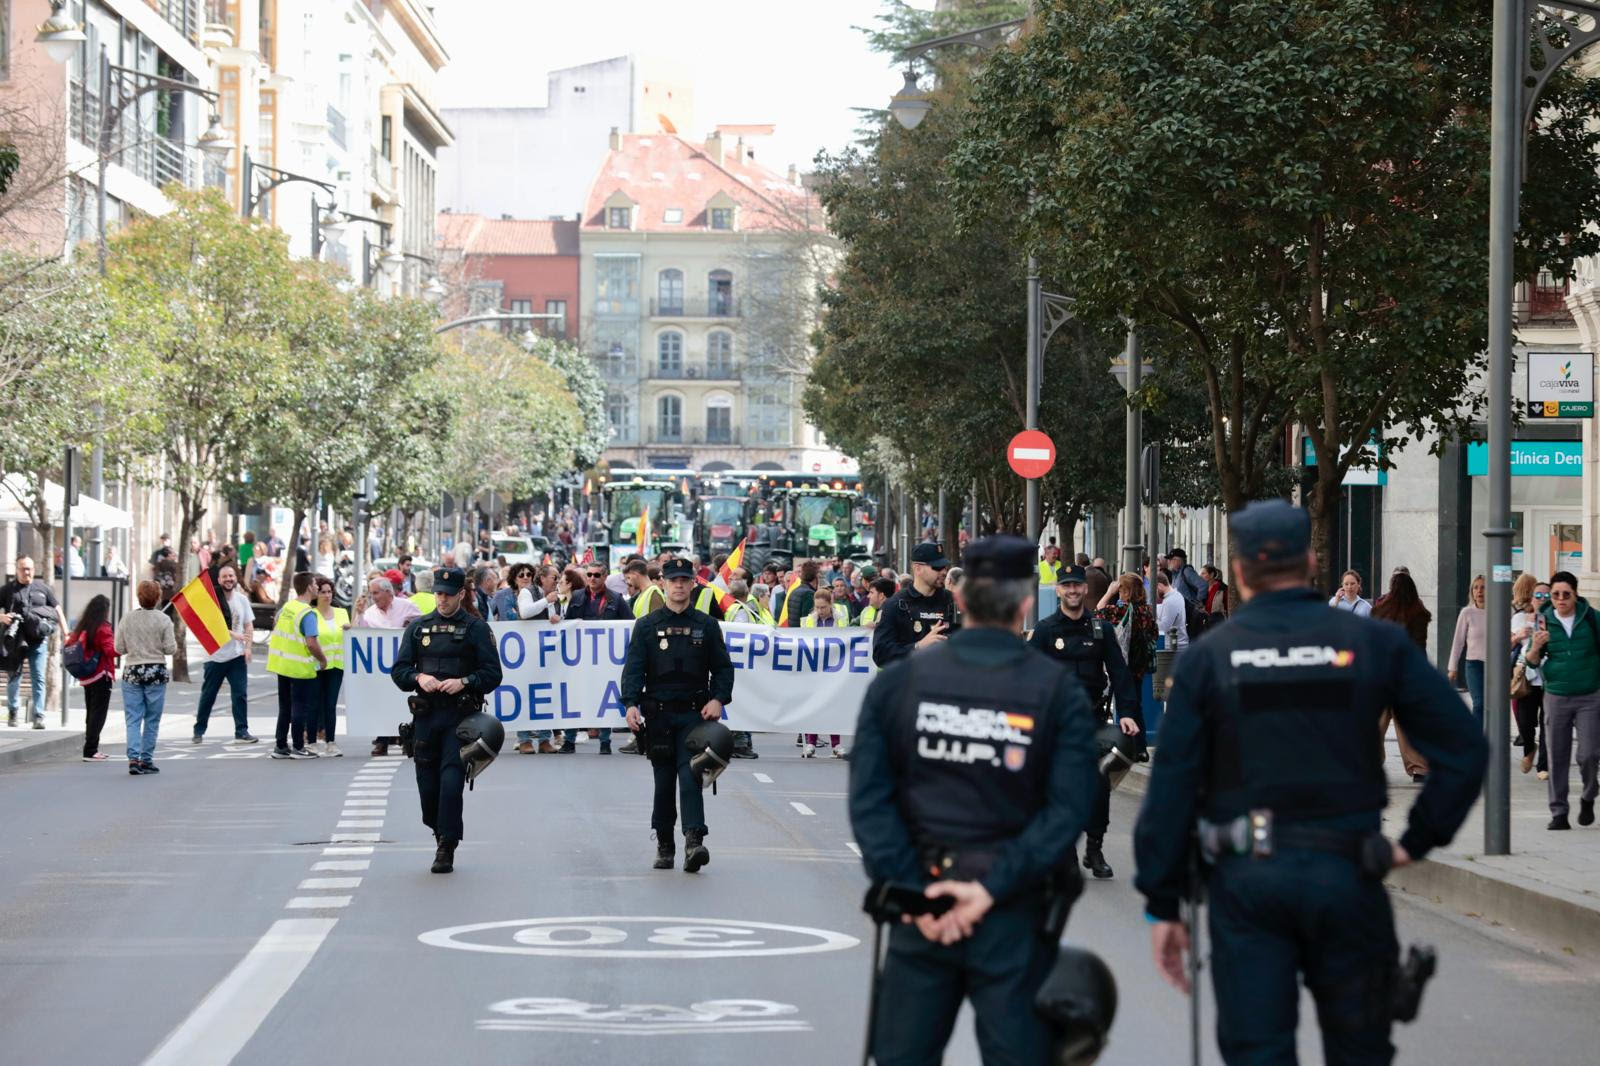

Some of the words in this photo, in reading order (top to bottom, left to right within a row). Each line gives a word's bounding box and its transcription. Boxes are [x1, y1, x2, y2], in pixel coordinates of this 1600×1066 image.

[1540, 379, 1580, 389] cajaviva
[1554, 451, 1582, 465] Den
[538, 627, 631, 668] FUTU
[725, 631, 870, 674] EPENDE
[494, 682, 581, 722] DEL
